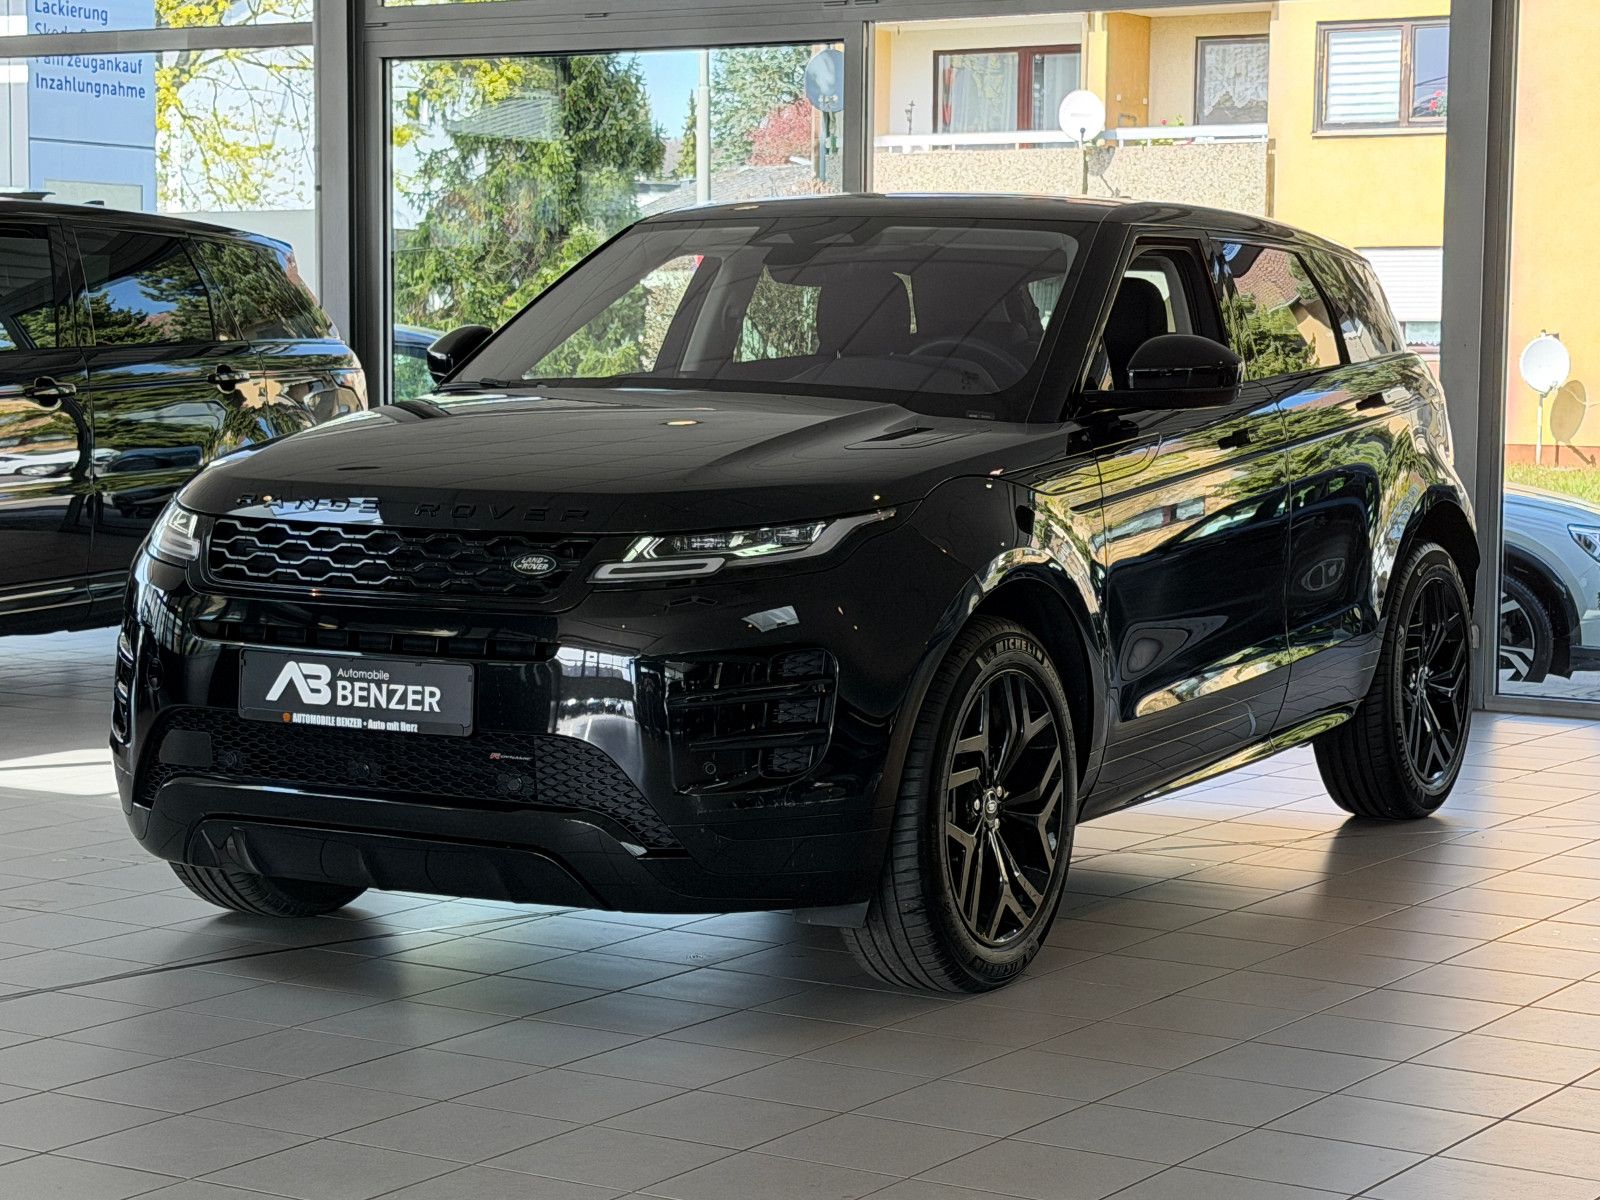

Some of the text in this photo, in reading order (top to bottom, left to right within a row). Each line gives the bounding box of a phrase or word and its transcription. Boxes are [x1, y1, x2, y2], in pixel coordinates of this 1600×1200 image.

[34, 0, 108, 26] Lackierung
[36, 55, 142, 74] ahrzeugankauf
[35, 73, 146, 99] Inzahlungnahme
[236, 494, 590, 522] RANGE ROVER
[996, 638, 1044, 660] MICHELIN
[336, 668, 390, 681] Automobile
[336, 680, 441, 713] BENZER
[292, 712, 336, 726] AUTOMOBILE
[336, 717, 362, 728] BENZER
[368, 719, 386, 730] Auto
[386, 721, 400, 732] mit
